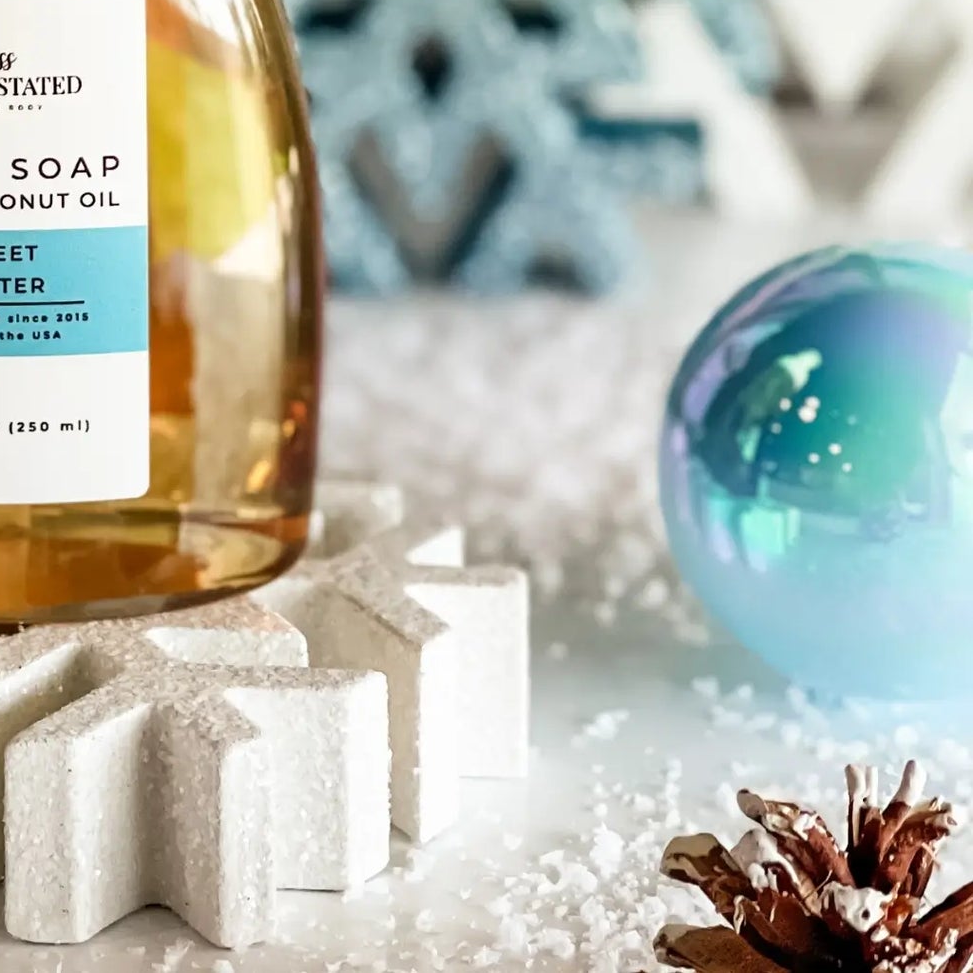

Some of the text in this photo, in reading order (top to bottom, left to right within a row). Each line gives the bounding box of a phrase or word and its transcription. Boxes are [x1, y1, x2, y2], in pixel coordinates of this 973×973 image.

[11, 155, 120, 180] SOAP
[79, 191, 120, 208] OIL
[7, 312, 49, 323] since
[55, 312, 90, 323] 2015
[0, 330, 25, 341] the
[32, 329, 62, 340] USA
[8, 420, 50, 435] (250
[59, 419, 91, 434] ml)
